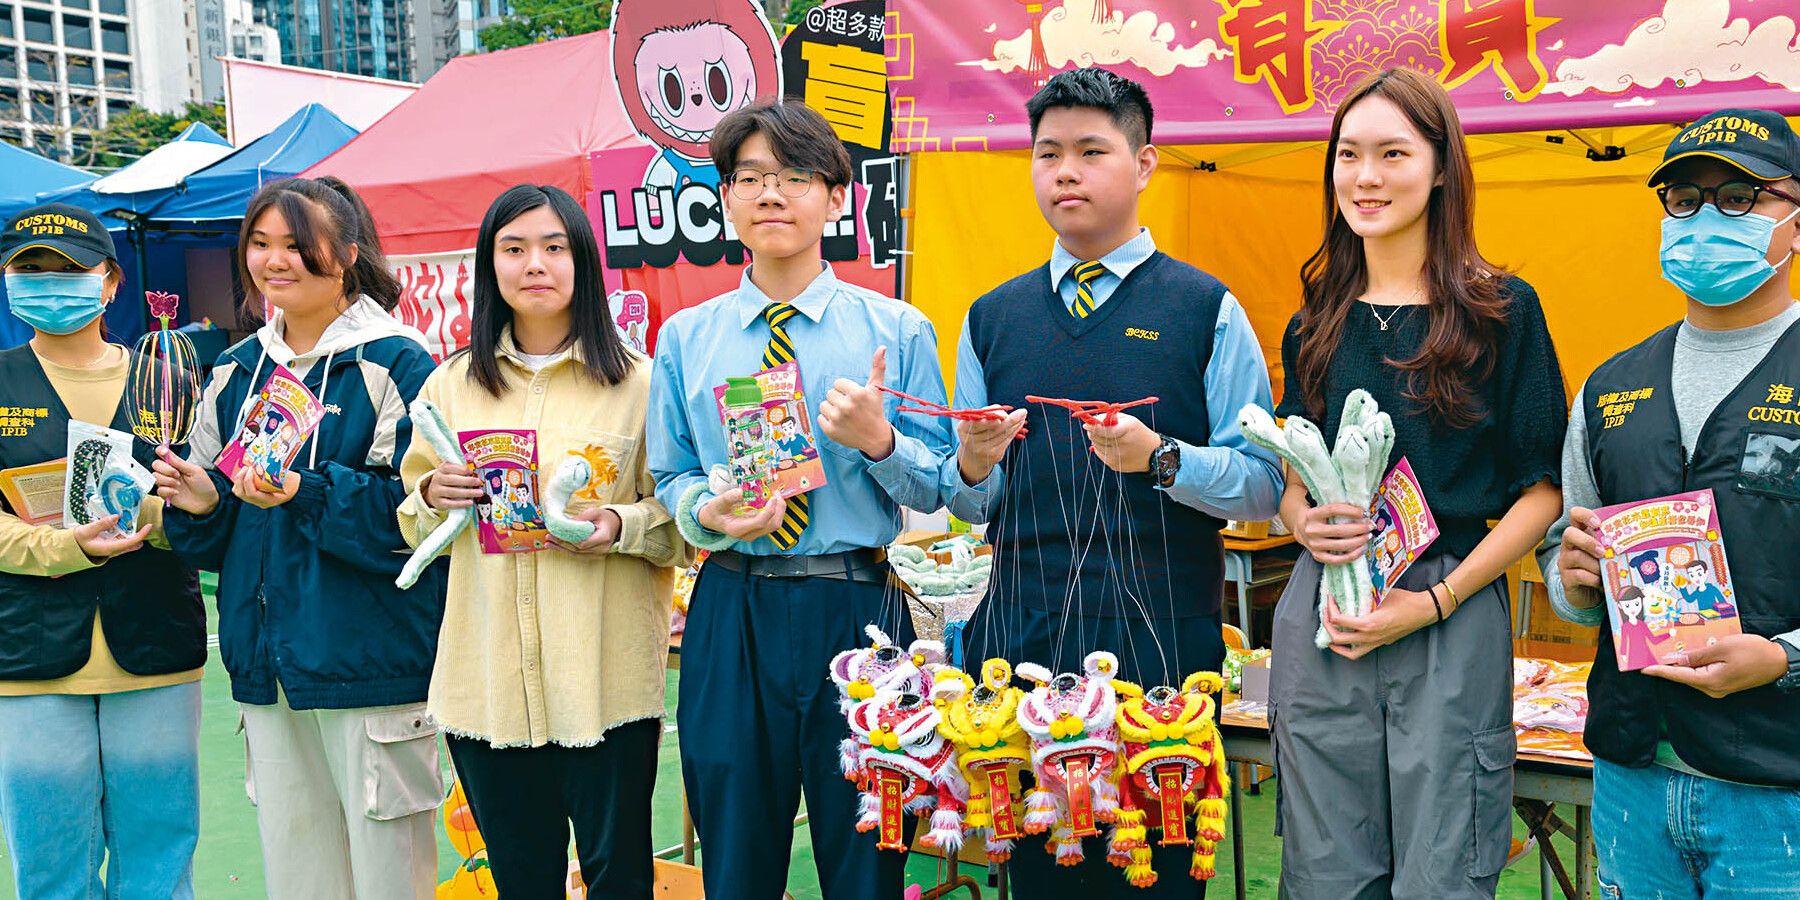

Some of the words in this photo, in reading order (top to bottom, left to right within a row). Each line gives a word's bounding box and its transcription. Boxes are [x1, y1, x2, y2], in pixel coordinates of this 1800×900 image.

[1680, 116, 1770, 143] CUSTOMS
[1697, 131, 1737, 146] IPIB
[15, 213, 88, 233] CUSTOMS
[32, 226, 64, 236] IPIB
[1765, 383, 1800, 406] 海
[1604, 414, 1625, 429] IPIB
[1, 427, 28, 437] IPIB
